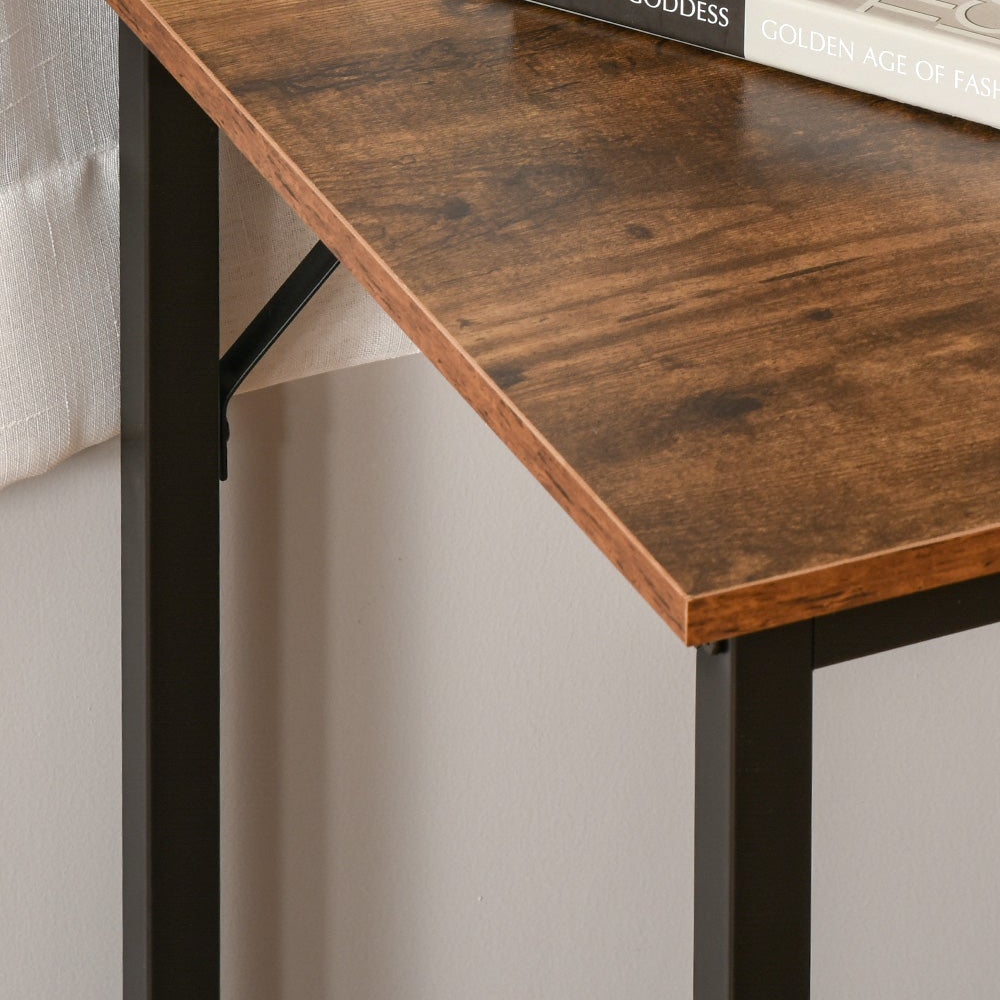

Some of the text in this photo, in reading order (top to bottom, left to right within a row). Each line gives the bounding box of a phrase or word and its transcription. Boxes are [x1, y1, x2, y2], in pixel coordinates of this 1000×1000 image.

[761, 19, 854, 61] GOLDEN
[863, 46, 907, 75] AGE
[916, 60, 945, 85] OF
